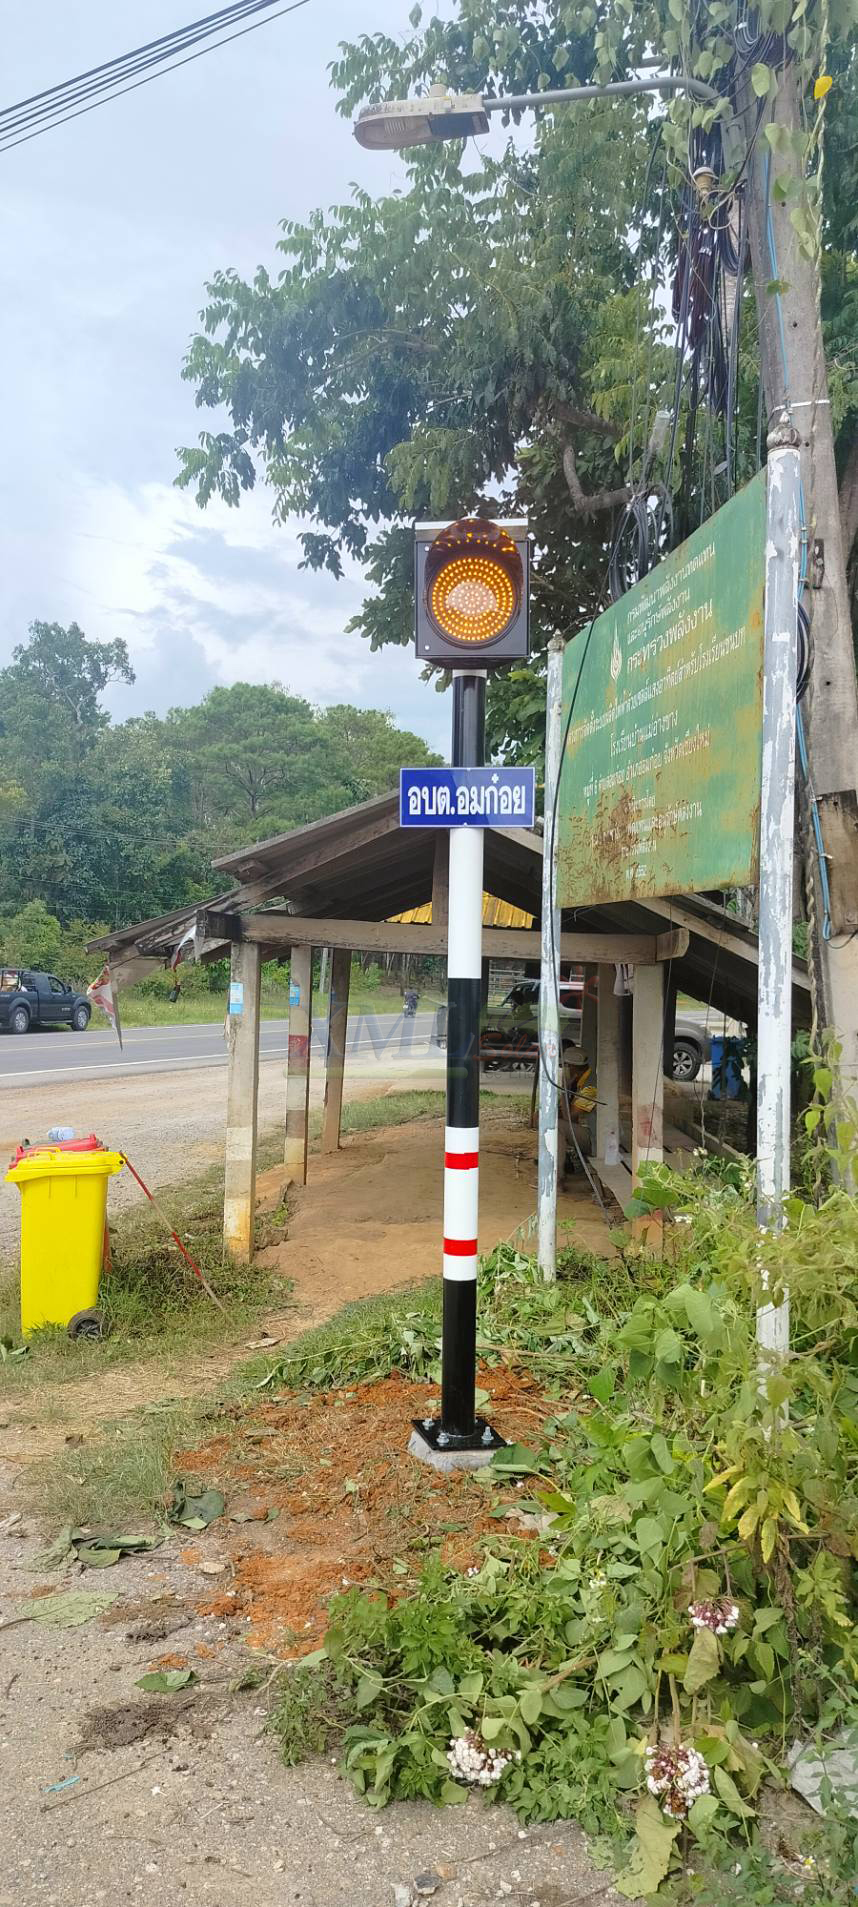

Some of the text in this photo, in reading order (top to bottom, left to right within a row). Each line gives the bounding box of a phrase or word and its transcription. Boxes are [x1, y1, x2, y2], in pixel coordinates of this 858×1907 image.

[627, 598, 713, 673] กระทรวงพลังงาน
[408, 773, 526, 815] อบต.อมก๋อย
